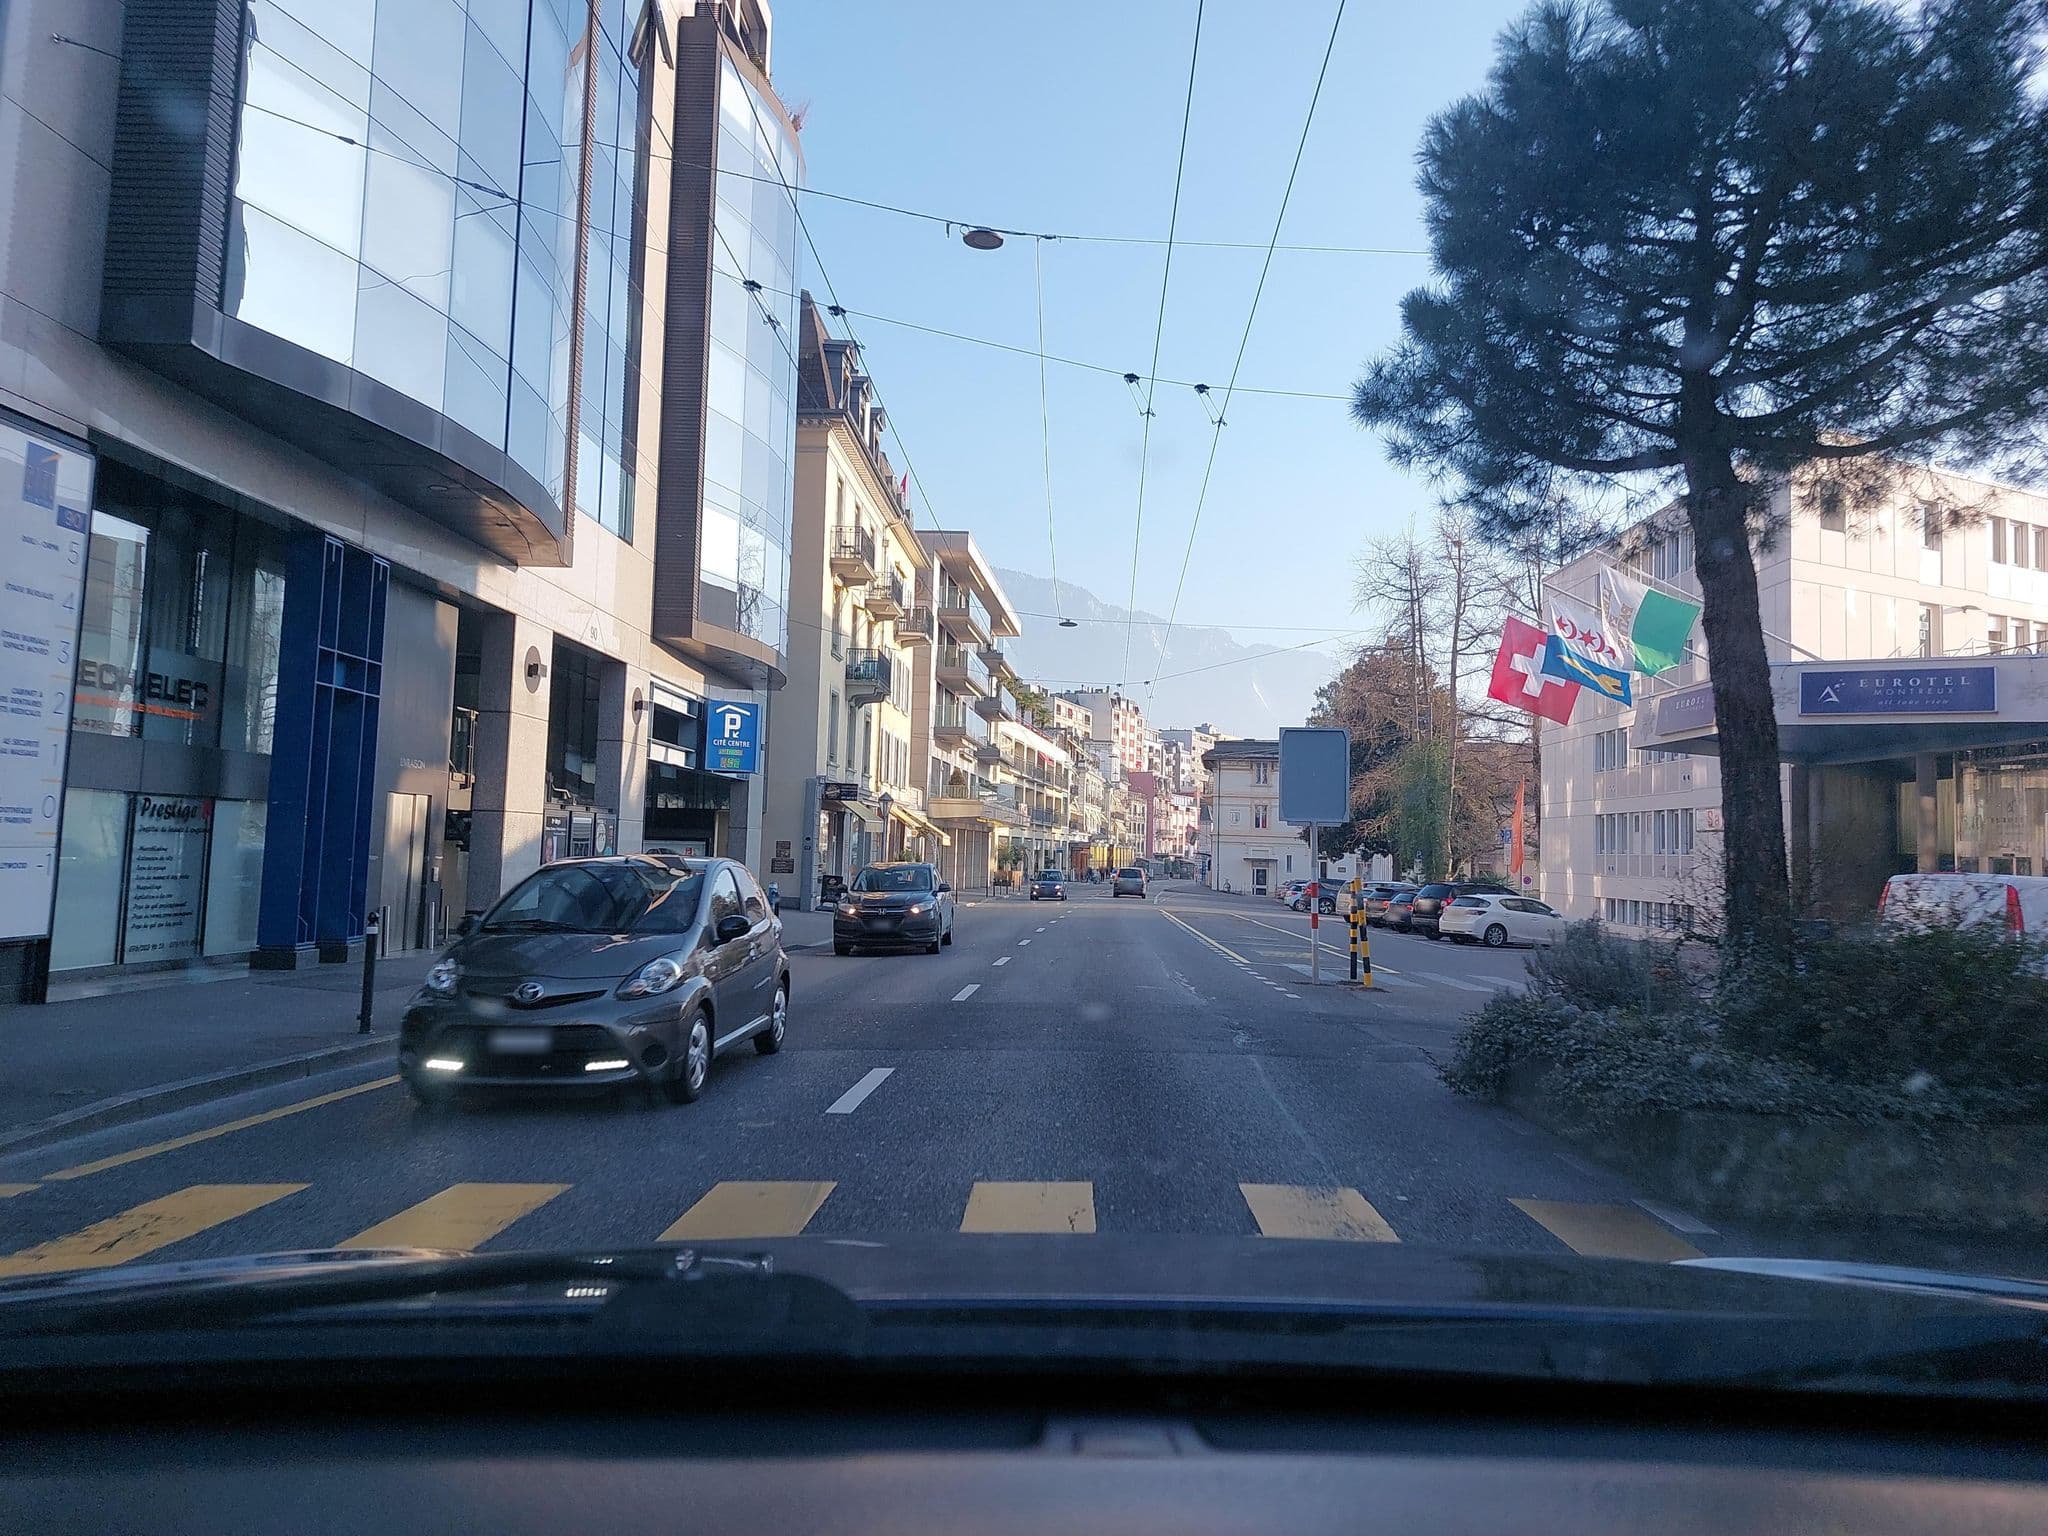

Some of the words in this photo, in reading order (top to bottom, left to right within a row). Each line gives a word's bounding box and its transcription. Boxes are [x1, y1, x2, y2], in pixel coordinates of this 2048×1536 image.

[67, 541, 80, 565] 5
[61, 591, 75, 613] 4
[57, 639, 71, 664] 3
[147, 672, 209, 706] ELEC
[1859, 676, 1971, 687] EUROTEL
[53, 691, 65, 715] 2
[724, 712, 742, 738] P
[727, 740, 751, 748] CENTRE
[41, 795, 57, 819] 0
[140, 797, 199, 823] Prestige
